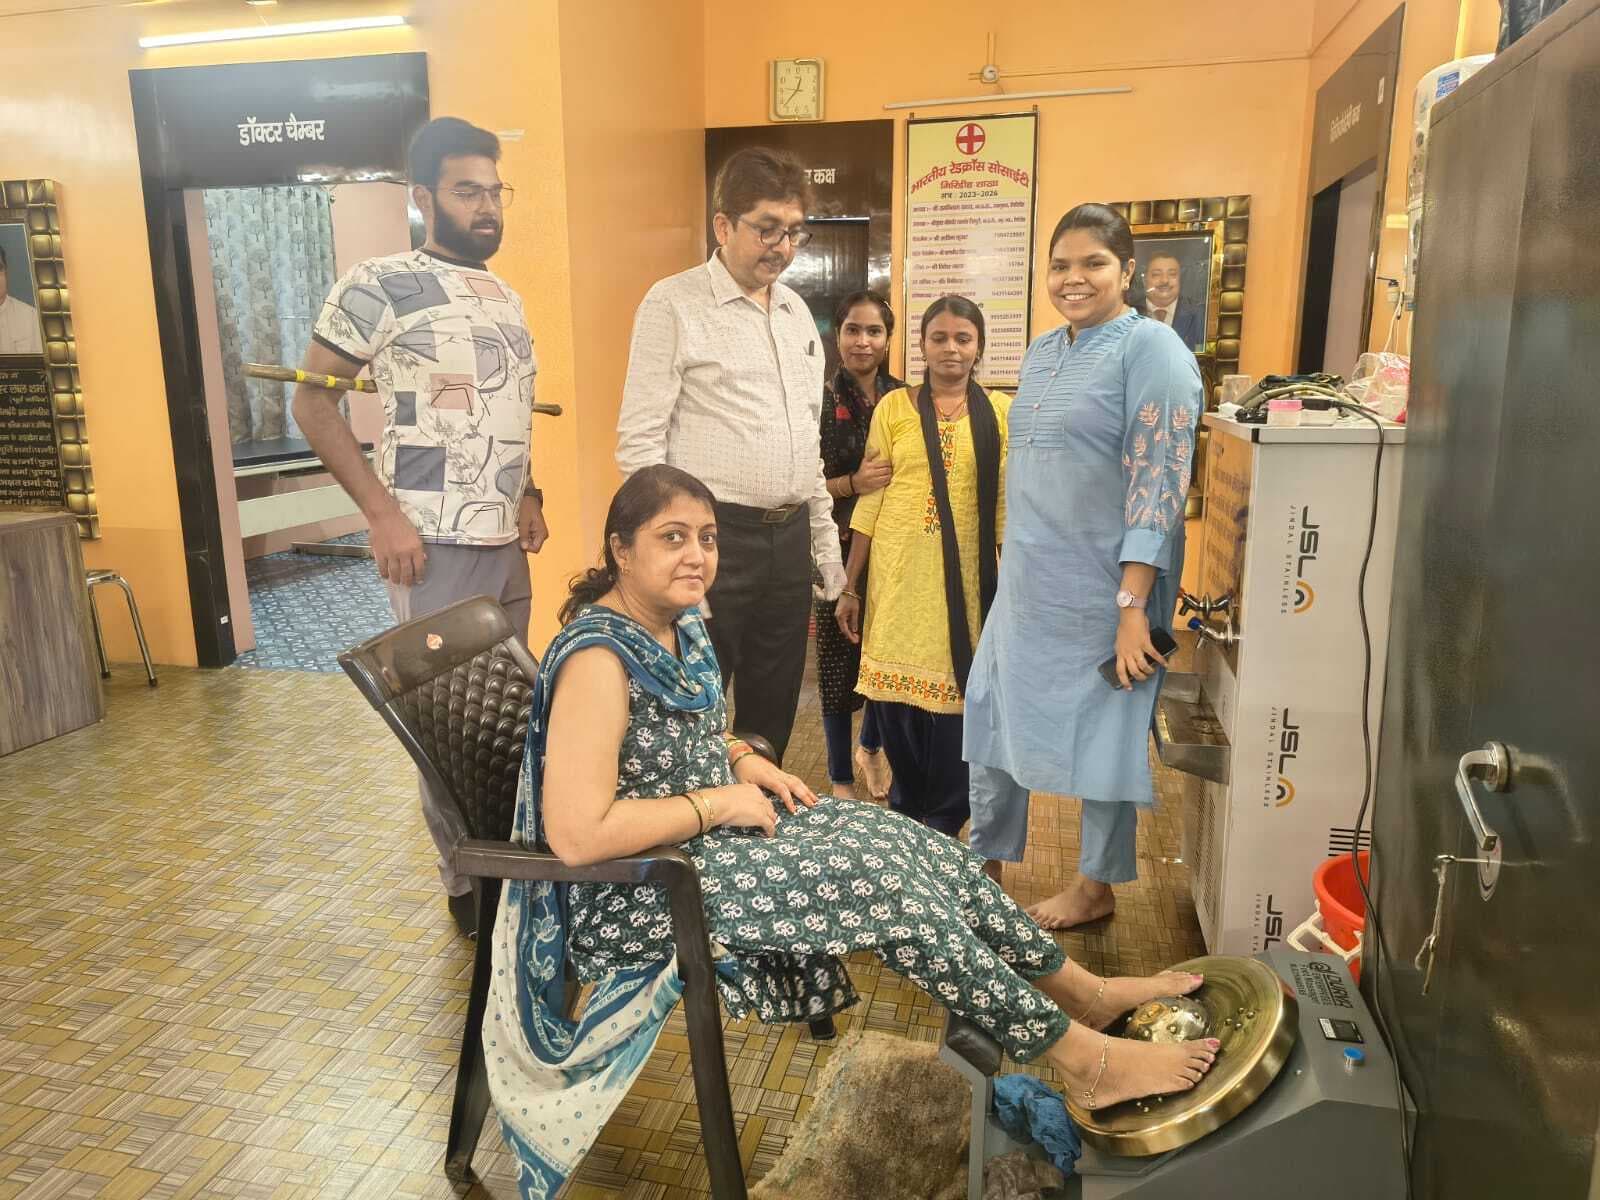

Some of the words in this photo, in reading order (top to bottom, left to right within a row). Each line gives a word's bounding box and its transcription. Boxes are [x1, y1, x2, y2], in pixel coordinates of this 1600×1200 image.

[237, 116, 283, 146] डॉक्टर
[284, 112, 326, 142] चैम्बर
[813, 168, 836, 185] कक्ष
[911, 166, 947, 194] भारतीय
[949, 159, 985, 175] रेडक्रॉस
[959, 190, 998, 199] 2023-2026
